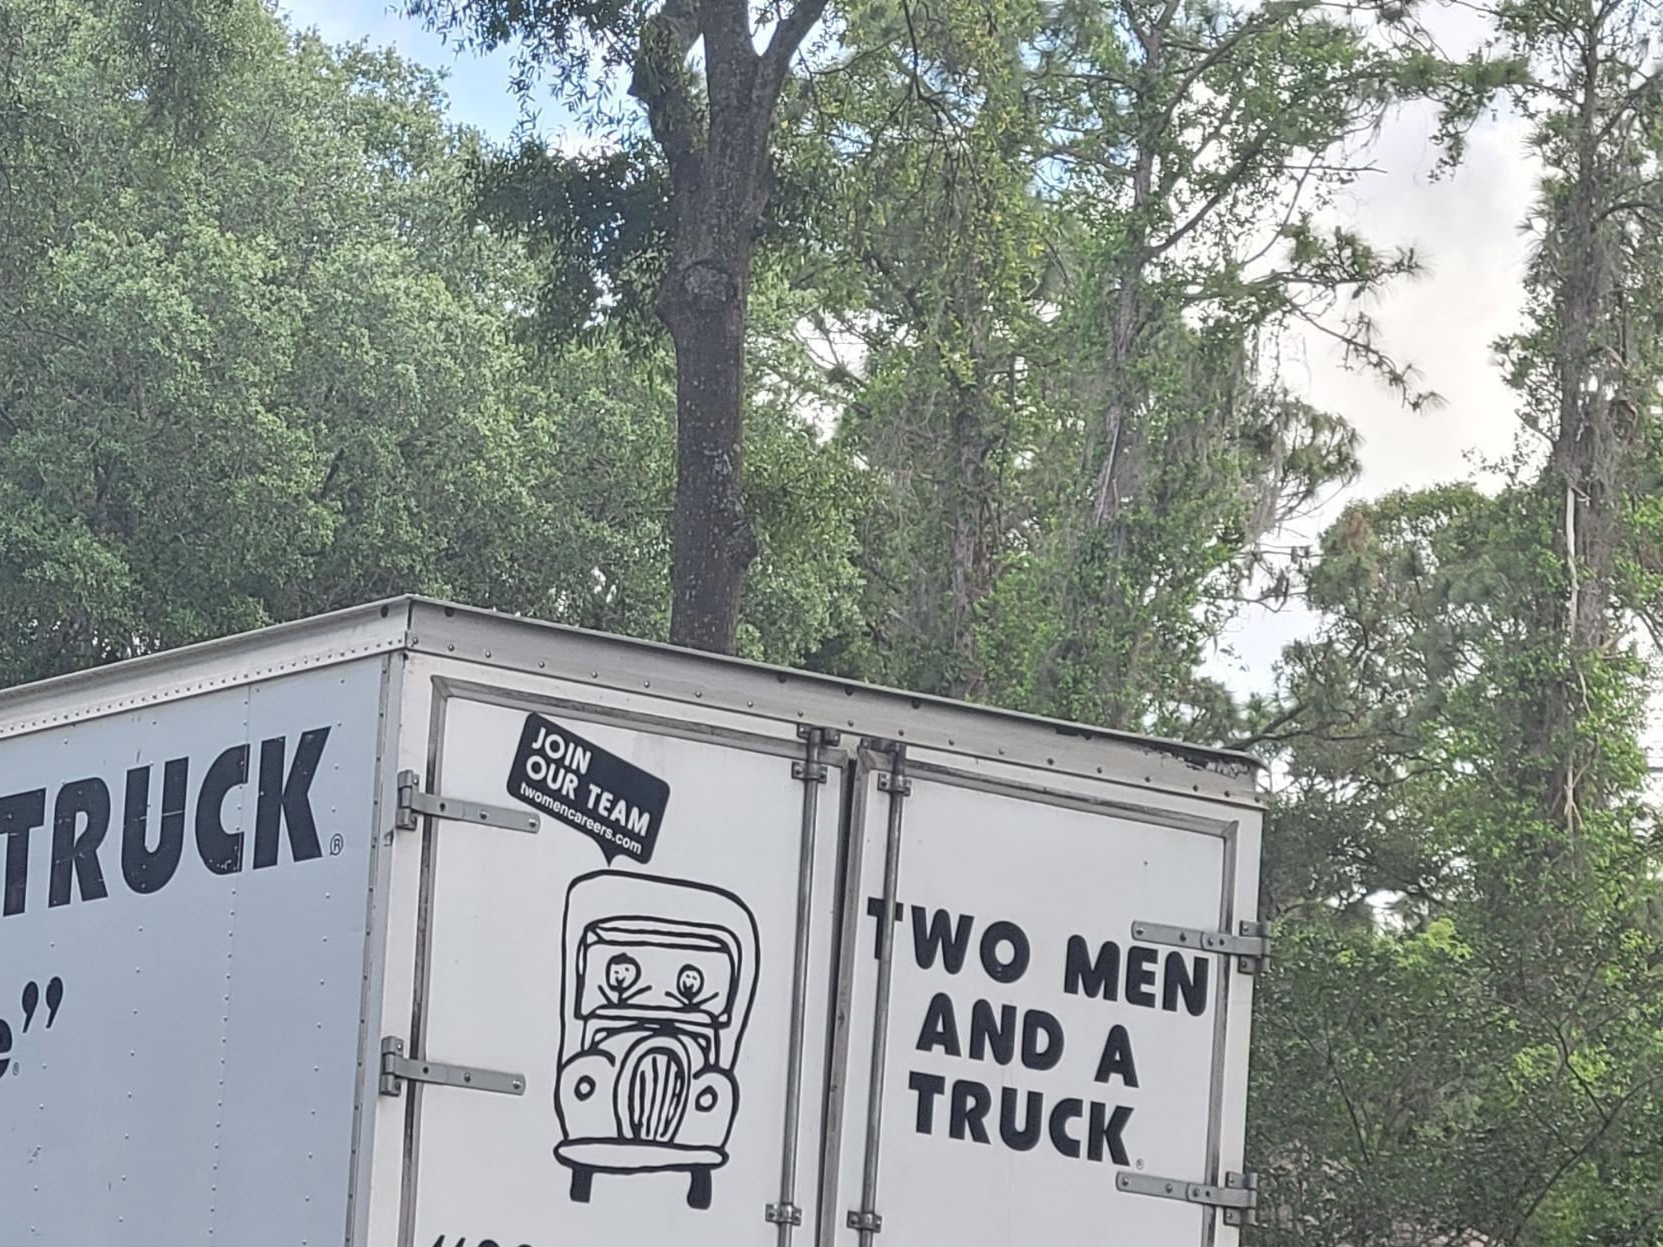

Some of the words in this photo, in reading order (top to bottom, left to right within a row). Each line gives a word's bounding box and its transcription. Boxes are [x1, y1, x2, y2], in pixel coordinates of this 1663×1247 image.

[532, 727, 591, 775] JOIN
[520, 782, 642, 854] twomencareers.com
[526, 755, 579, 800] OUR
[587, 783, 650, 837] TEAM
[867, 896, 1030, 984] TWO
[1064, 935, 1209, 1017] MEN
[917, 992, 1065, 1071] AND
[1095, 1024, 1139, 1088] A
[908, 1071, 1135, 1167] TRUCK
